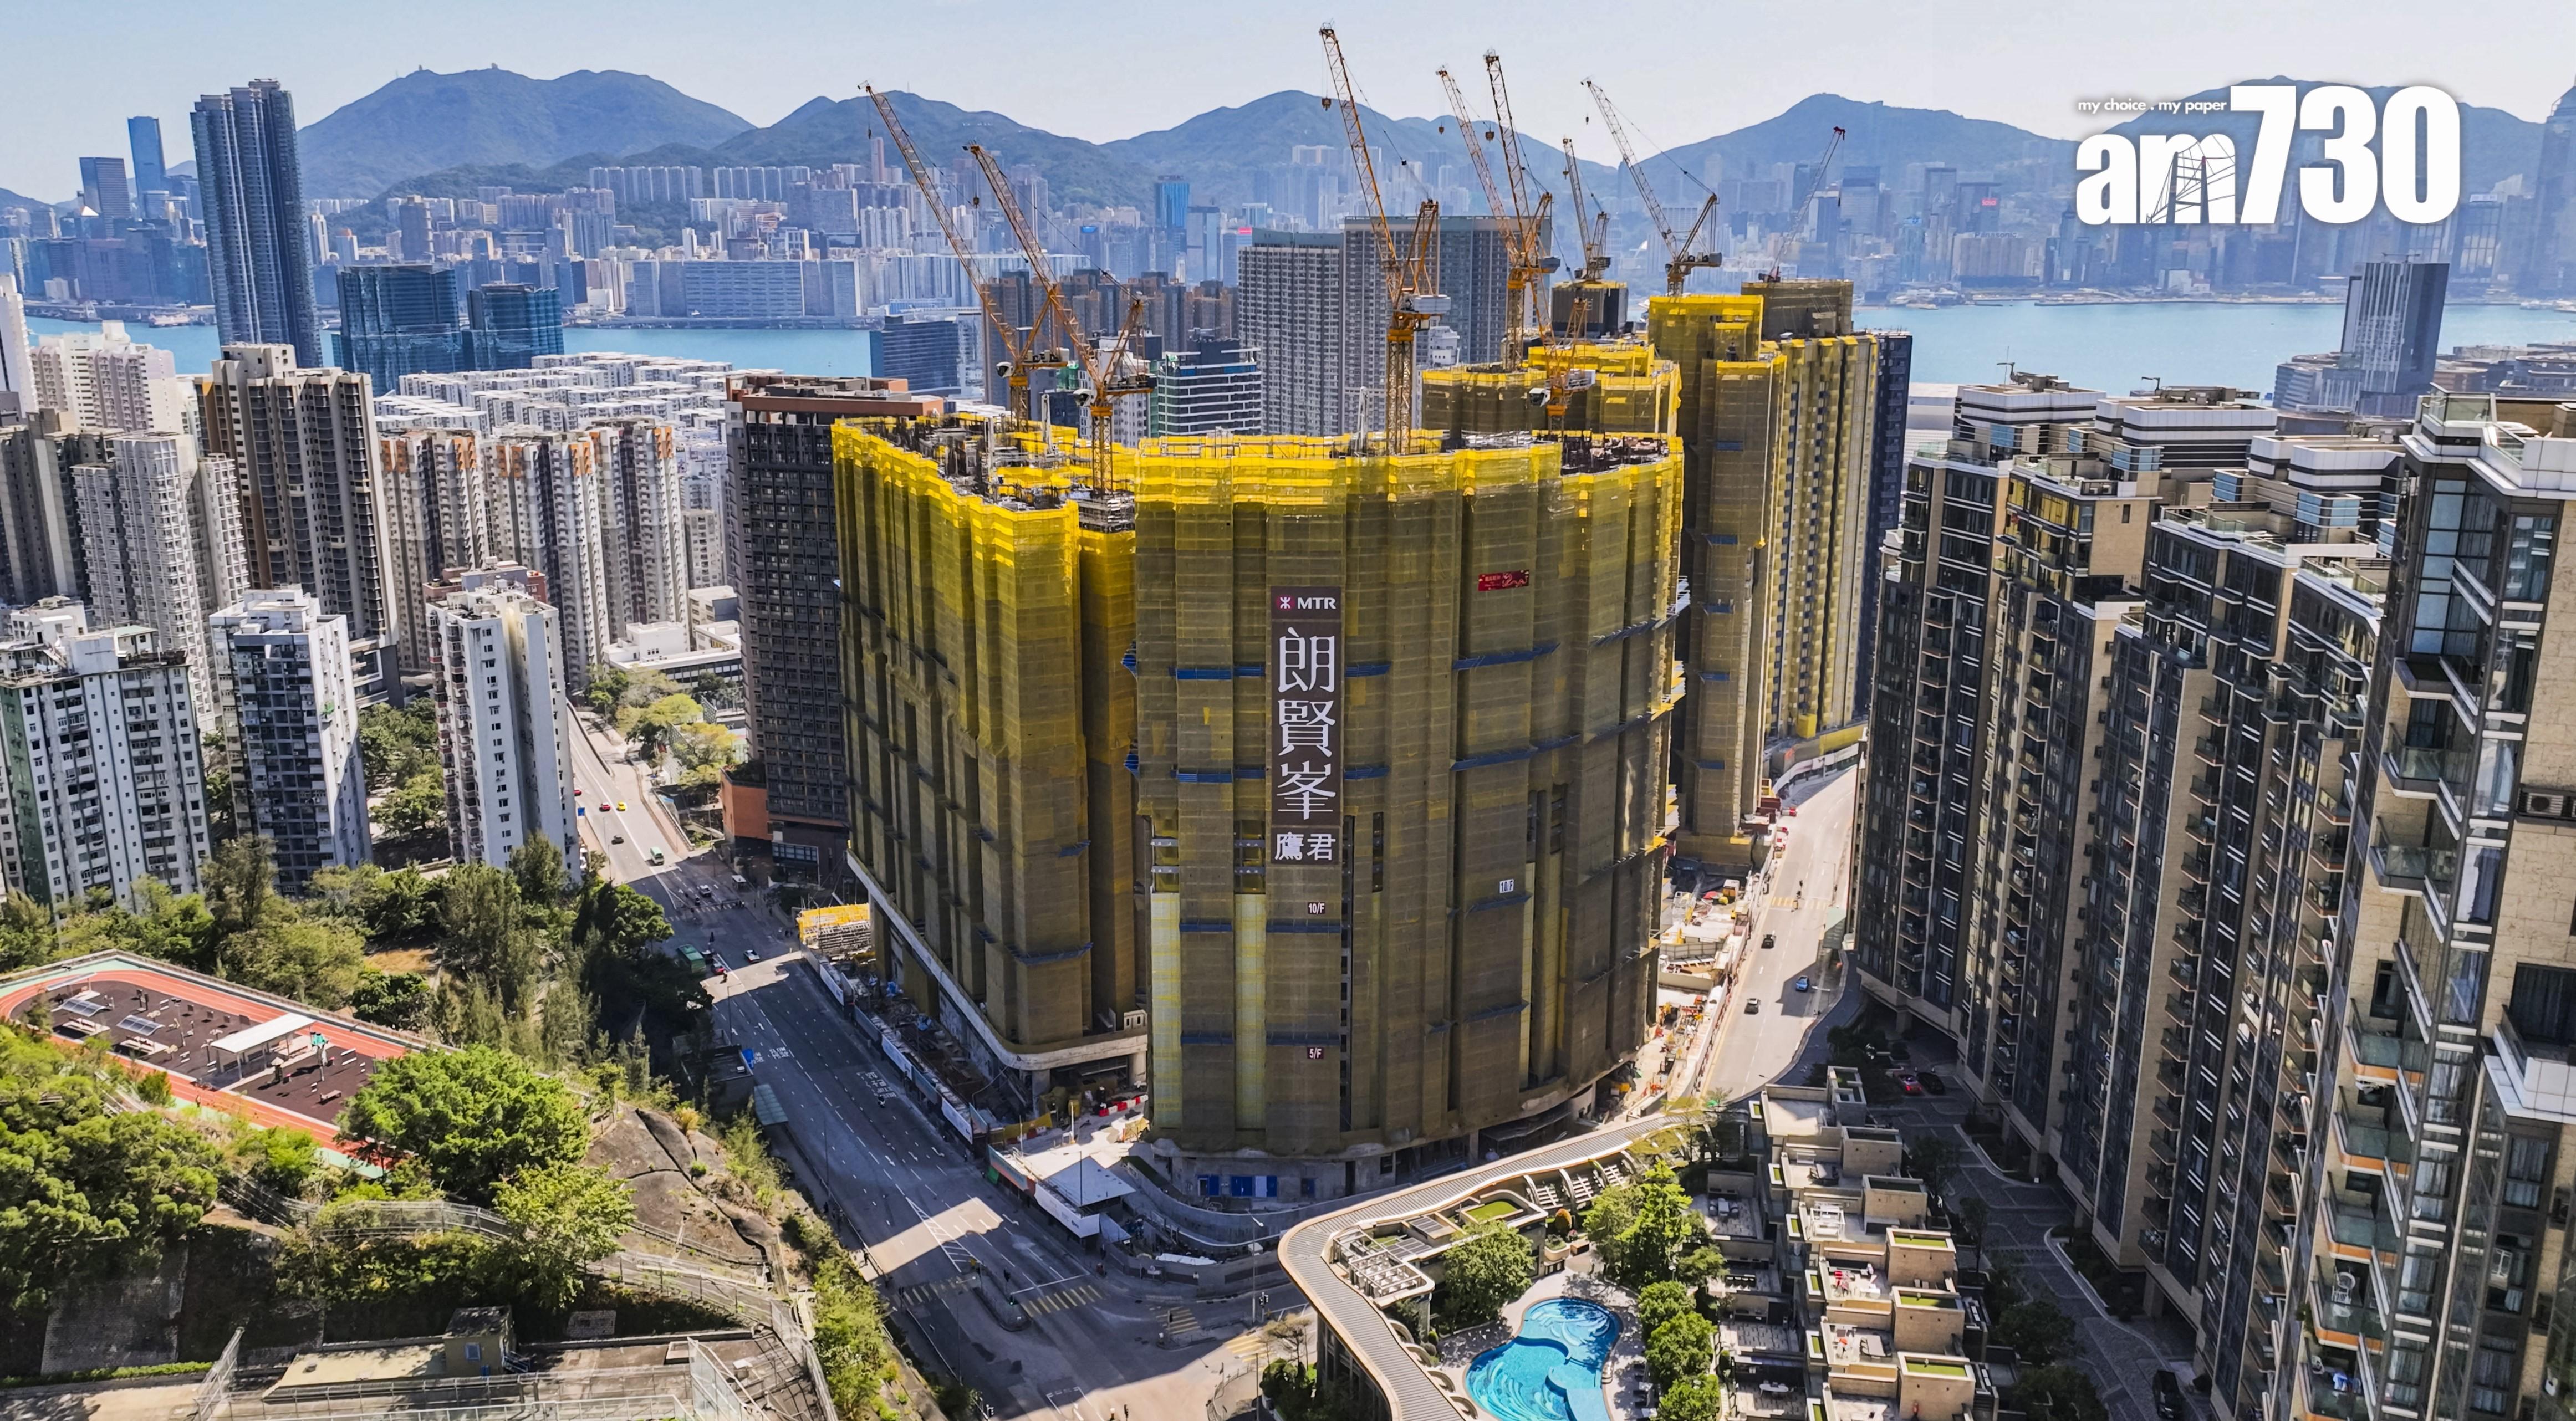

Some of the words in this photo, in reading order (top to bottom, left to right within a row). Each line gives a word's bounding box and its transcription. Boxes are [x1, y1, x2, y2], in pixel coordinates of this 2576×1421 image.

[1297, 597, 1337, 610] MTR
[1277, 626, 1337, 821] 朗賢峯
[1274, 831, 1336, 861] 鷹君
[1308, 902, 1325, 915] 10/F
[1309, 1047, 1322, 1060] 5/F
